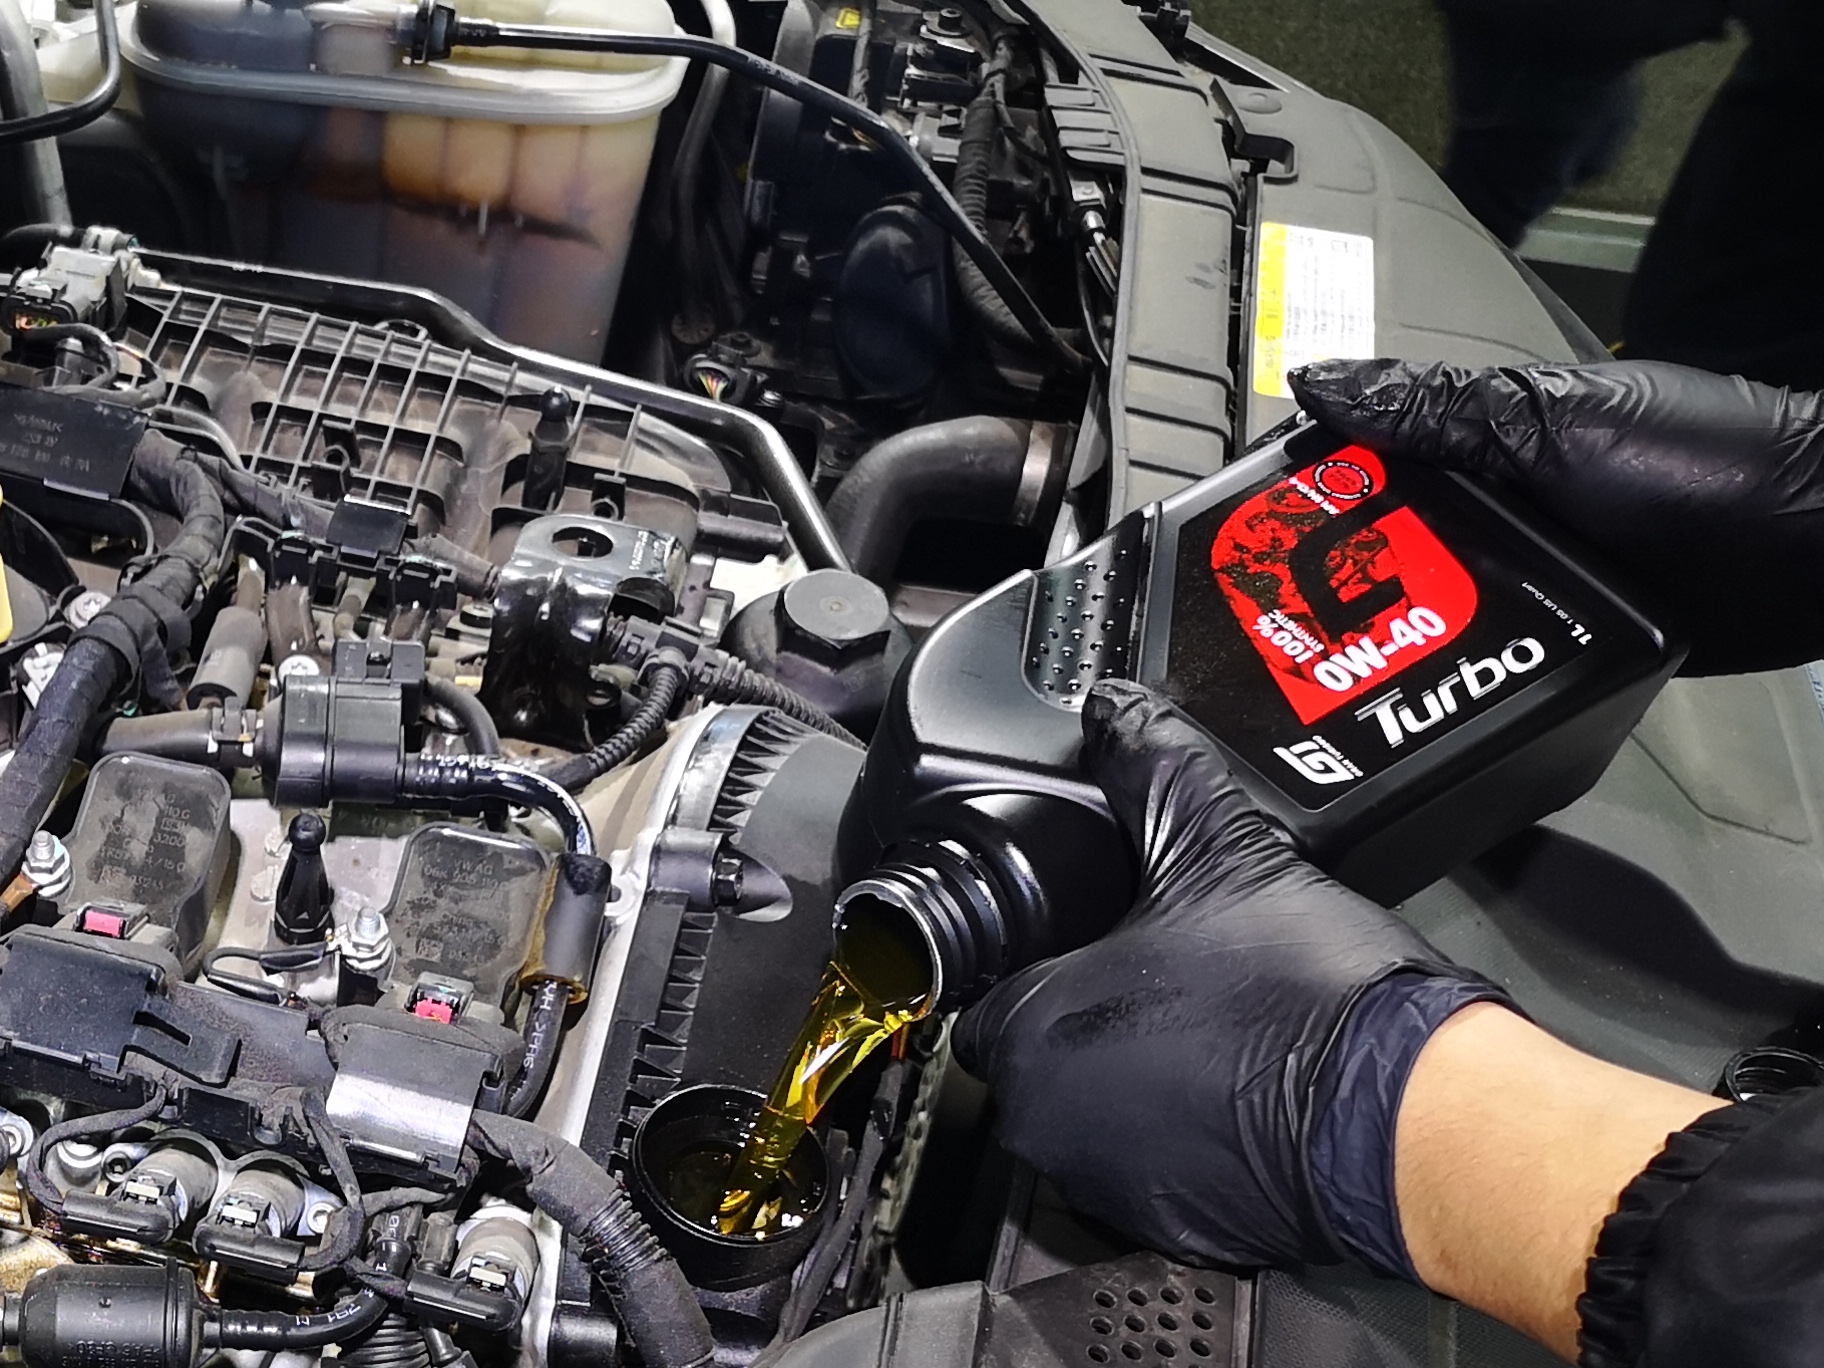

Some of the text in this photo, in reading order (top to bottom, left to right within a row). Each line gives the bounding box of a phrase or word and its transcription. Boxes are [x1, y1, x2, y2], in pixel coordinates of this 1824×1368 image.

[1250, 614, 1315, 664] 100%
[1267, 608, 1325, 654] SYNTHETIC
[1313, 606, 1447, 692] 0W-40
[1570, 623, 1593, 646] 1L
[1354, 637, 1546, 749] Turbo
